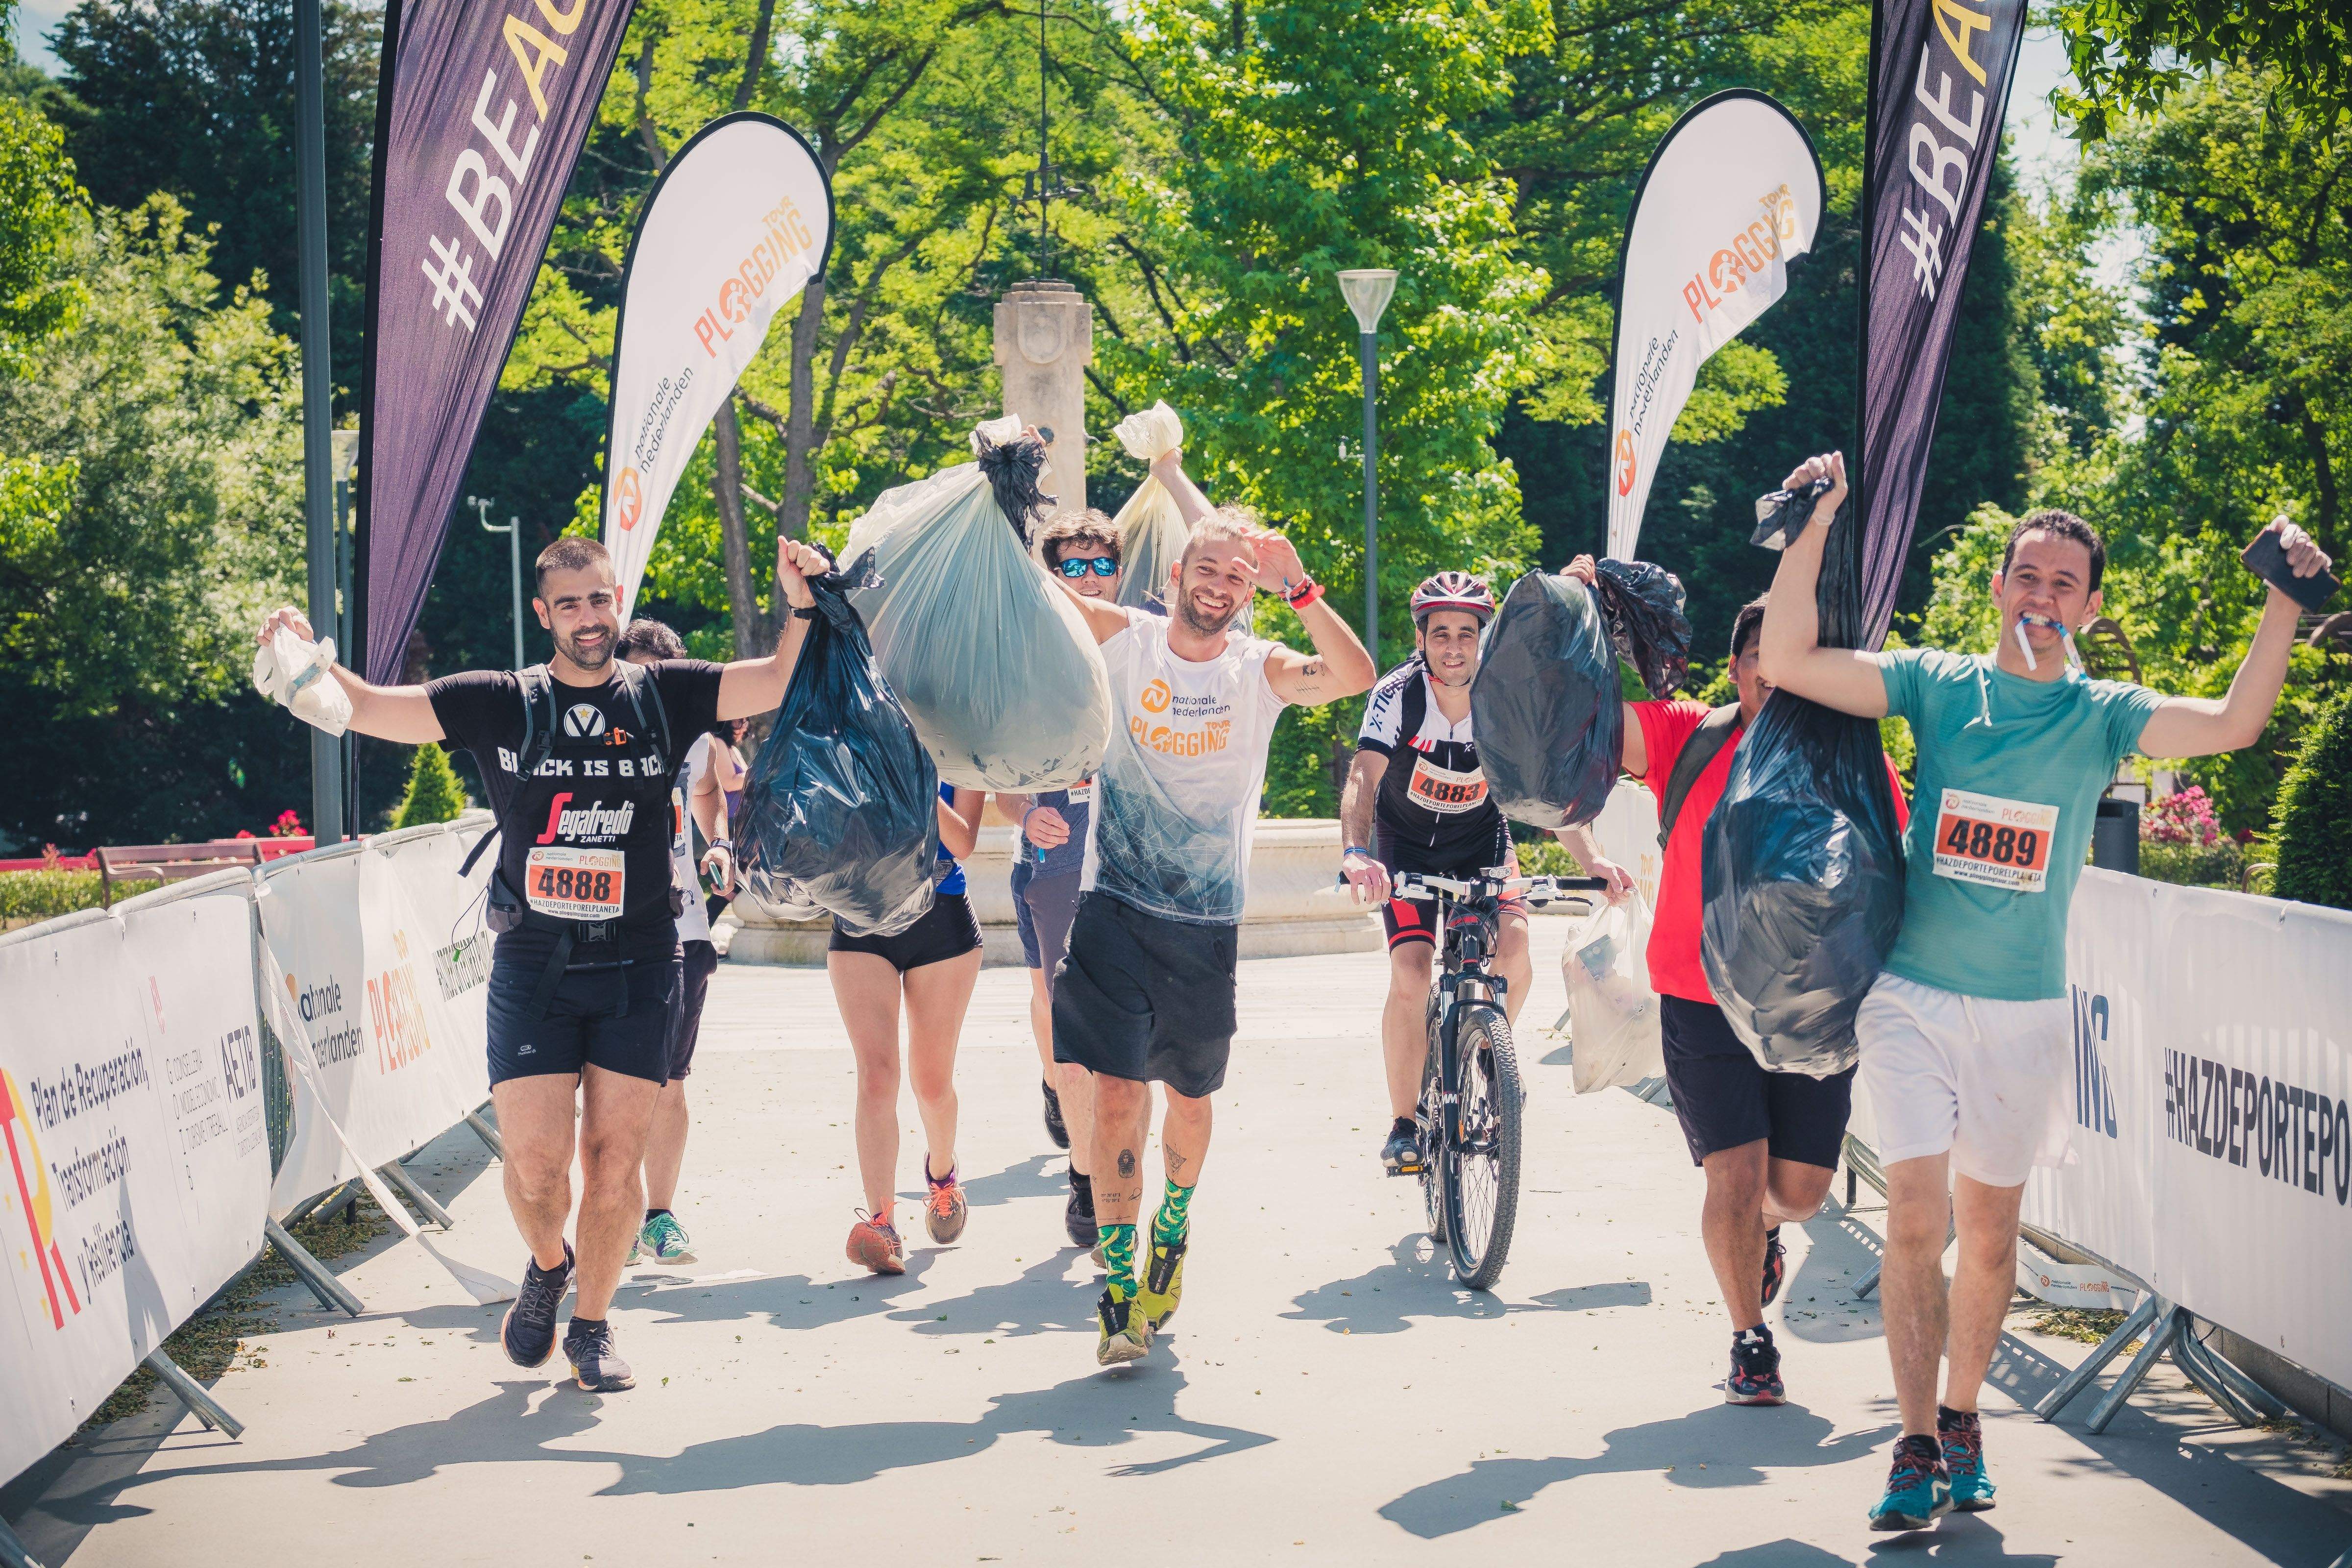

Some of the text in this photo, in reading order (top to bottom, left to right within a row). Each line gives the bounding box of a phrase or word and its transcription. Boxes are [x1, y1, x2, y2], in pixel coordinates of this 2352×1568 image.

[1900, 0, 1995, 302] #BEA
[761, 196, 794, 229] TOUR
[693, 208, 813, 359] PLOGGING
[1683, 198, 1794, 324] PLOGGIG
[634, 376, 670, 460] nationale
[639, 367, 693, 475] nederlanden
[1173, 695, 1217, 705] nationale
[1131, 715, 1230, 757] PLOGGING
[1205, 719, 1231, 730] TOUR
[497, 747, 573, 776] BLCK
[584, 760, 608, 776] IS
[1420, 777, 1480, 803] 4883
[536, 792, 634, 844] Segafredo
[580, 835, 616, 843] ZANETTI
[579, 855, 621, 868] PLOGGING
[1947, 819, 2038, 866] 4889
[530, 898, 619, 913] #HAZDEPORTEPORELPLANETA
[538, 868, 611, 901] 4888
[297, 974, 342, 1022] ationale
[31, 1035, 149, 1132] Plan de Recuperación,
[221, 1025, 256, 1104] AETIB
[2164, 1047, 2352, 1208] #HAZDEPORTEPO
[51, 1125, 132, 1212] Transformación
[77, 1209, 135, 1305] y Resiliencia
[2080, 1283, 2109, 1292] PLOGGING
